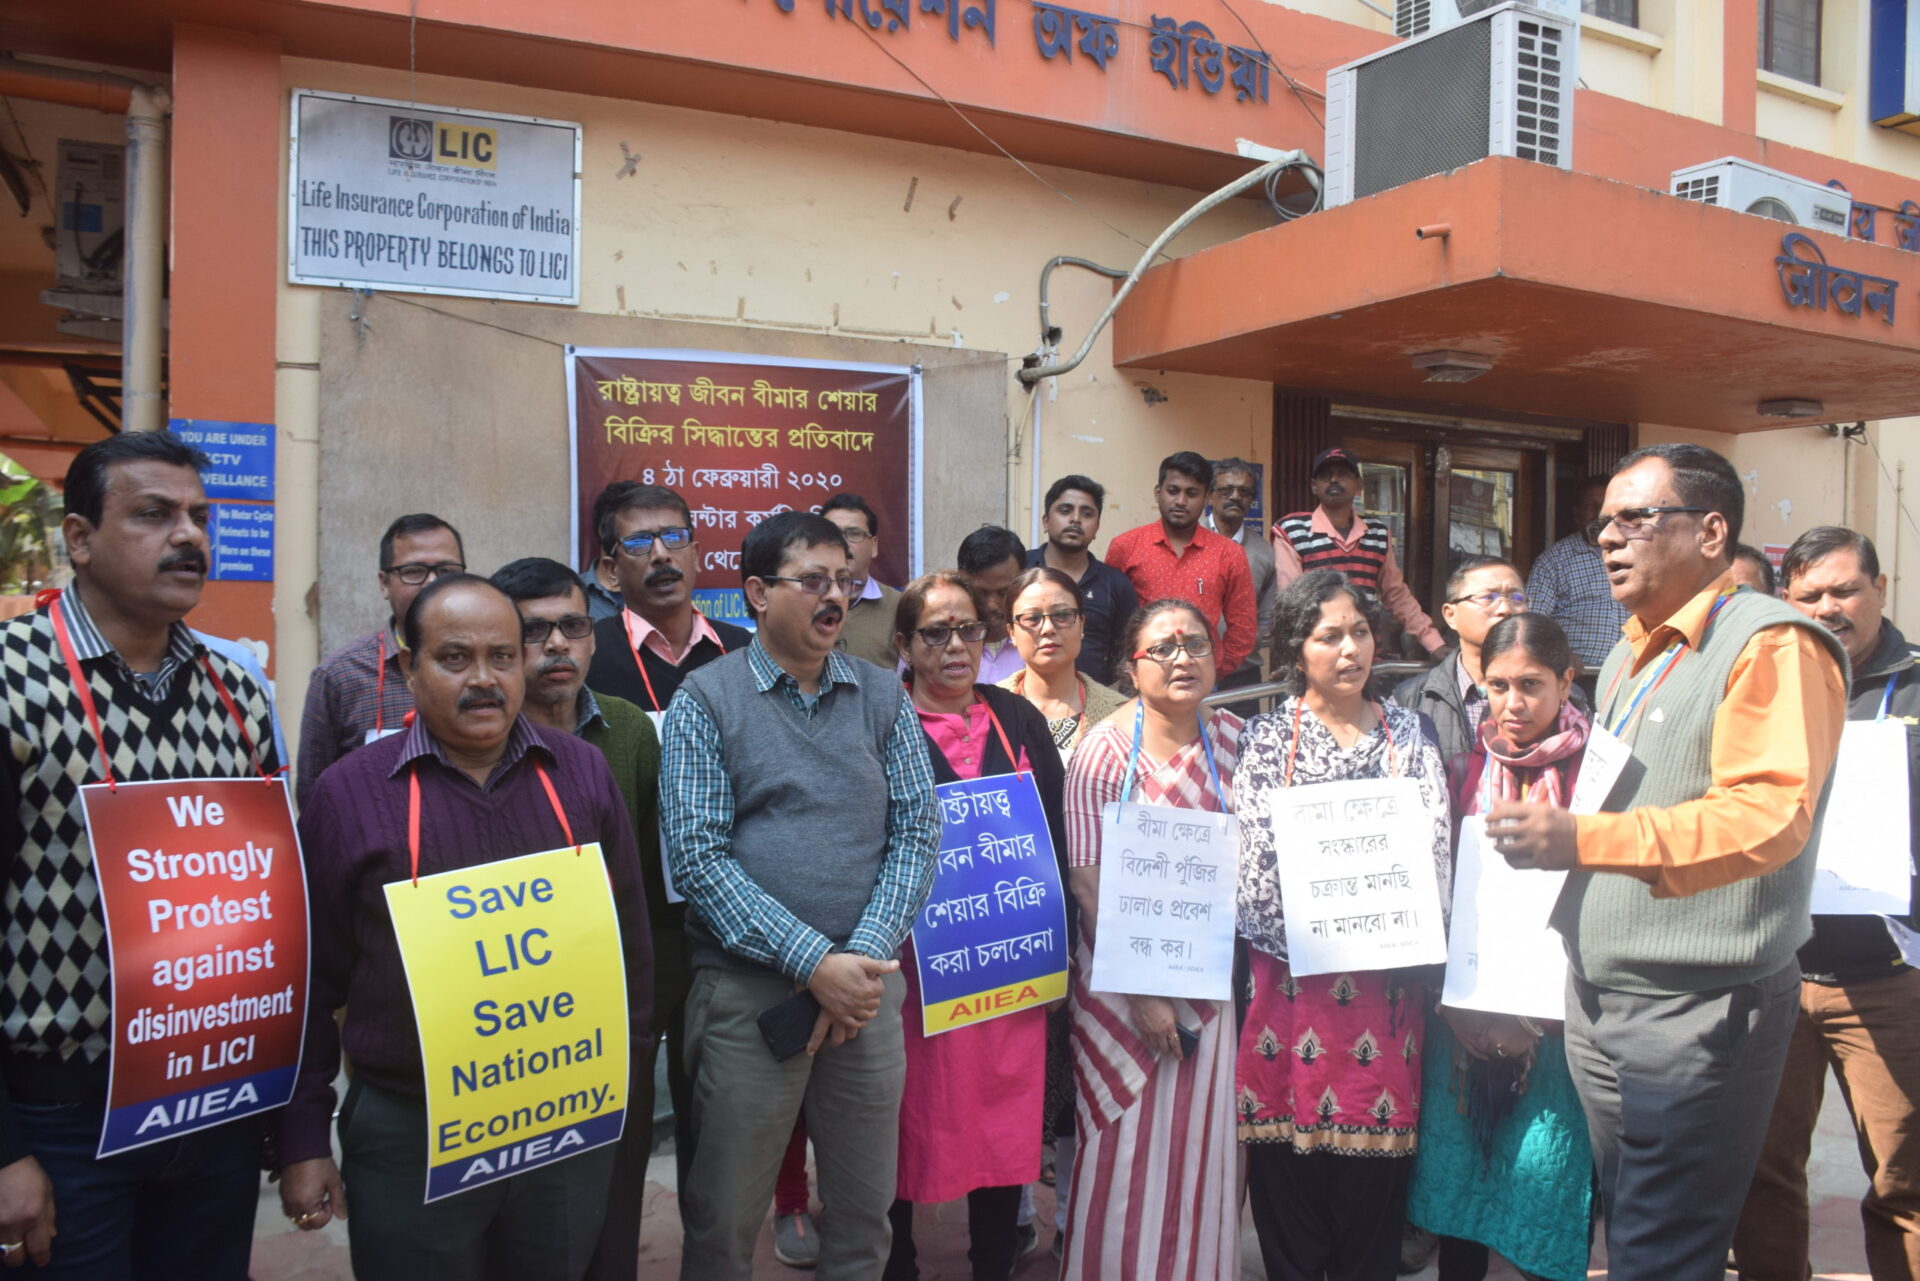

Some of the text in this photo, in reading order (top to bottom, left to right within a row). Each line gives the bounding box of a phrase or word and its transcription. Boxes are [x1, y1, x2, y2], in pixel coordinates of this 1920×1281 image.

[1031, 1, 1120, 73] অফ
[440, 128, 492, 162] LIC
[301, 180, 571, 236] Life Insurance Corporation of India
[301, 226, 568, 281] THIS PROPERTY BELONGS TO LICI
[1775, 232, 1899, 326] जीवन
[689, 377, 745, 407] জীবন
[752, 379, 809, 410] বীমার
[818, 389, 878, 413] শেয়ার
[180, 431, 267, 446] YOU ARE UNDER
[604, 415, 875, 452] বিক্রির সিদ্ধান্তের প্রতিবাদে
[206, 452, 242, 466] CTV
[642, 460, 842, 492] ৪ ঠা ফেব্রুয়ারী ২০২০
[200, 473, 267, 488] VEILLANCE
[250, 528, 258, 538] to
[260, 528, 269, 538] be
[725, 592, 741, 619] LIC
[166, 794, 225, 828] We
[1137, 810, 1212, 844] বীমা ক্ষেত্রে
[126, 841, 273, 883] Strongly
[978, 832, 1037, 864] বীমার
[1318, 833, 1389, 857] সংস্কারের
[1120, 848, 1218, 886] বিদেশী পুঁজির
[1309, 863, 1413, 899] চক্রান্ত মানছি
[147, 889, 273, 934] Protest
[446, 877, 554, 920] Save
[925, 876, 1046, 929] শেয়ার বিক্রি
[1118, 894, 1212, 922] ঢালাও প্রবেশ
[1309, 919, 1329, 938] না
[1333, 912, 1387, 936] মানবো
[152, 938, 275, 992] against
[475, 928, 553, 978] LIC
[927, 927, 1054, 977] করা চলবেনা
[1129, 936, 1153, 958] বন্ধ
[127, 984, 294, 1045] disinvestment
[473, 991, 575, 1037] Save
[948, 985, 1040, 1022] AIIEA
[166, 1035, 256, 1081] in LICI
[451, 1027, 603, 1097] National
[134, 1082, 259, 1136] AIIEA
[438, 1083, 616, 1154] Economy.
[460, 1128, 586, 1184] AIIEA
